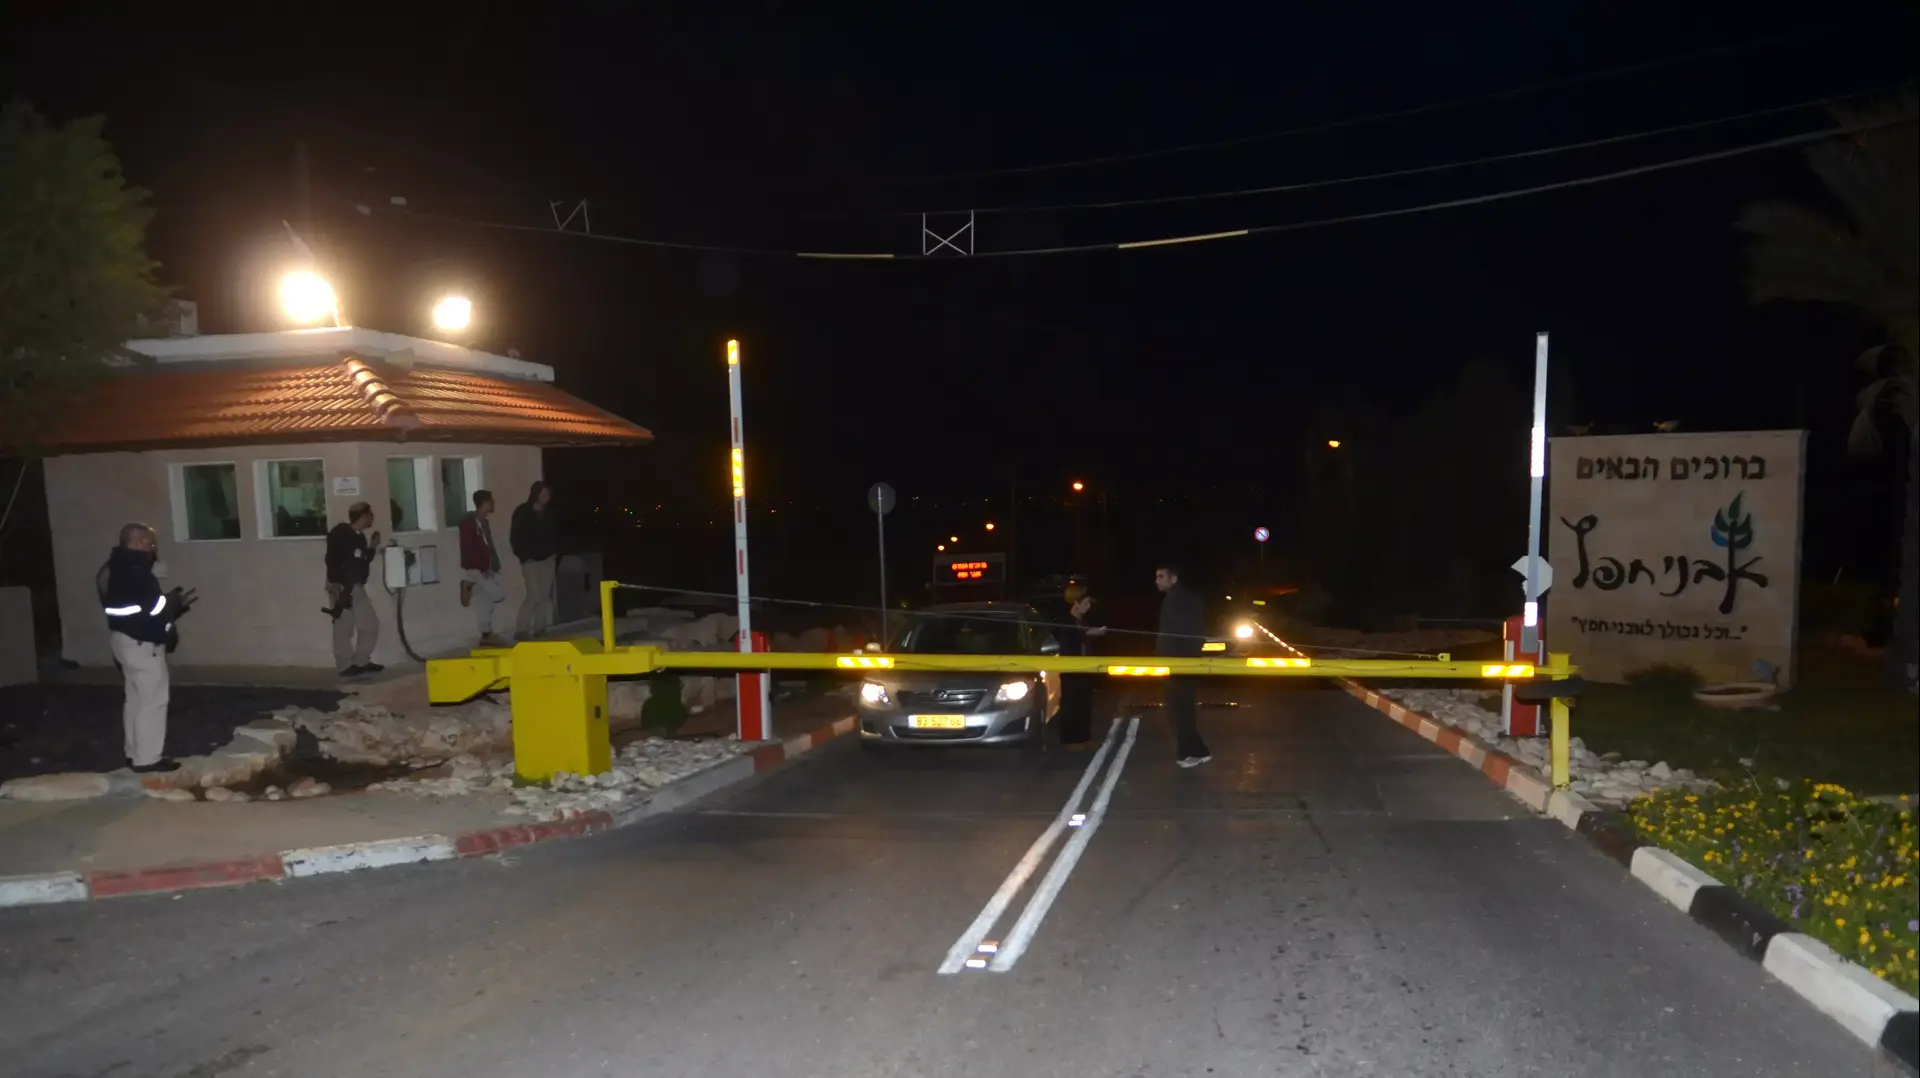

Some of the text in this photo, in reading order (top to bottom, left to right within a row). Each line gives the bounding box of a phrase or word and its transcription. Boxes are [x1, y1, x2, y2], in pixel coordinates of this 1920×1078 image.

[1576, 455, 1766, 480] ברוכים הבאים
[1561, 514, 1768, 615] אבני חפץ
